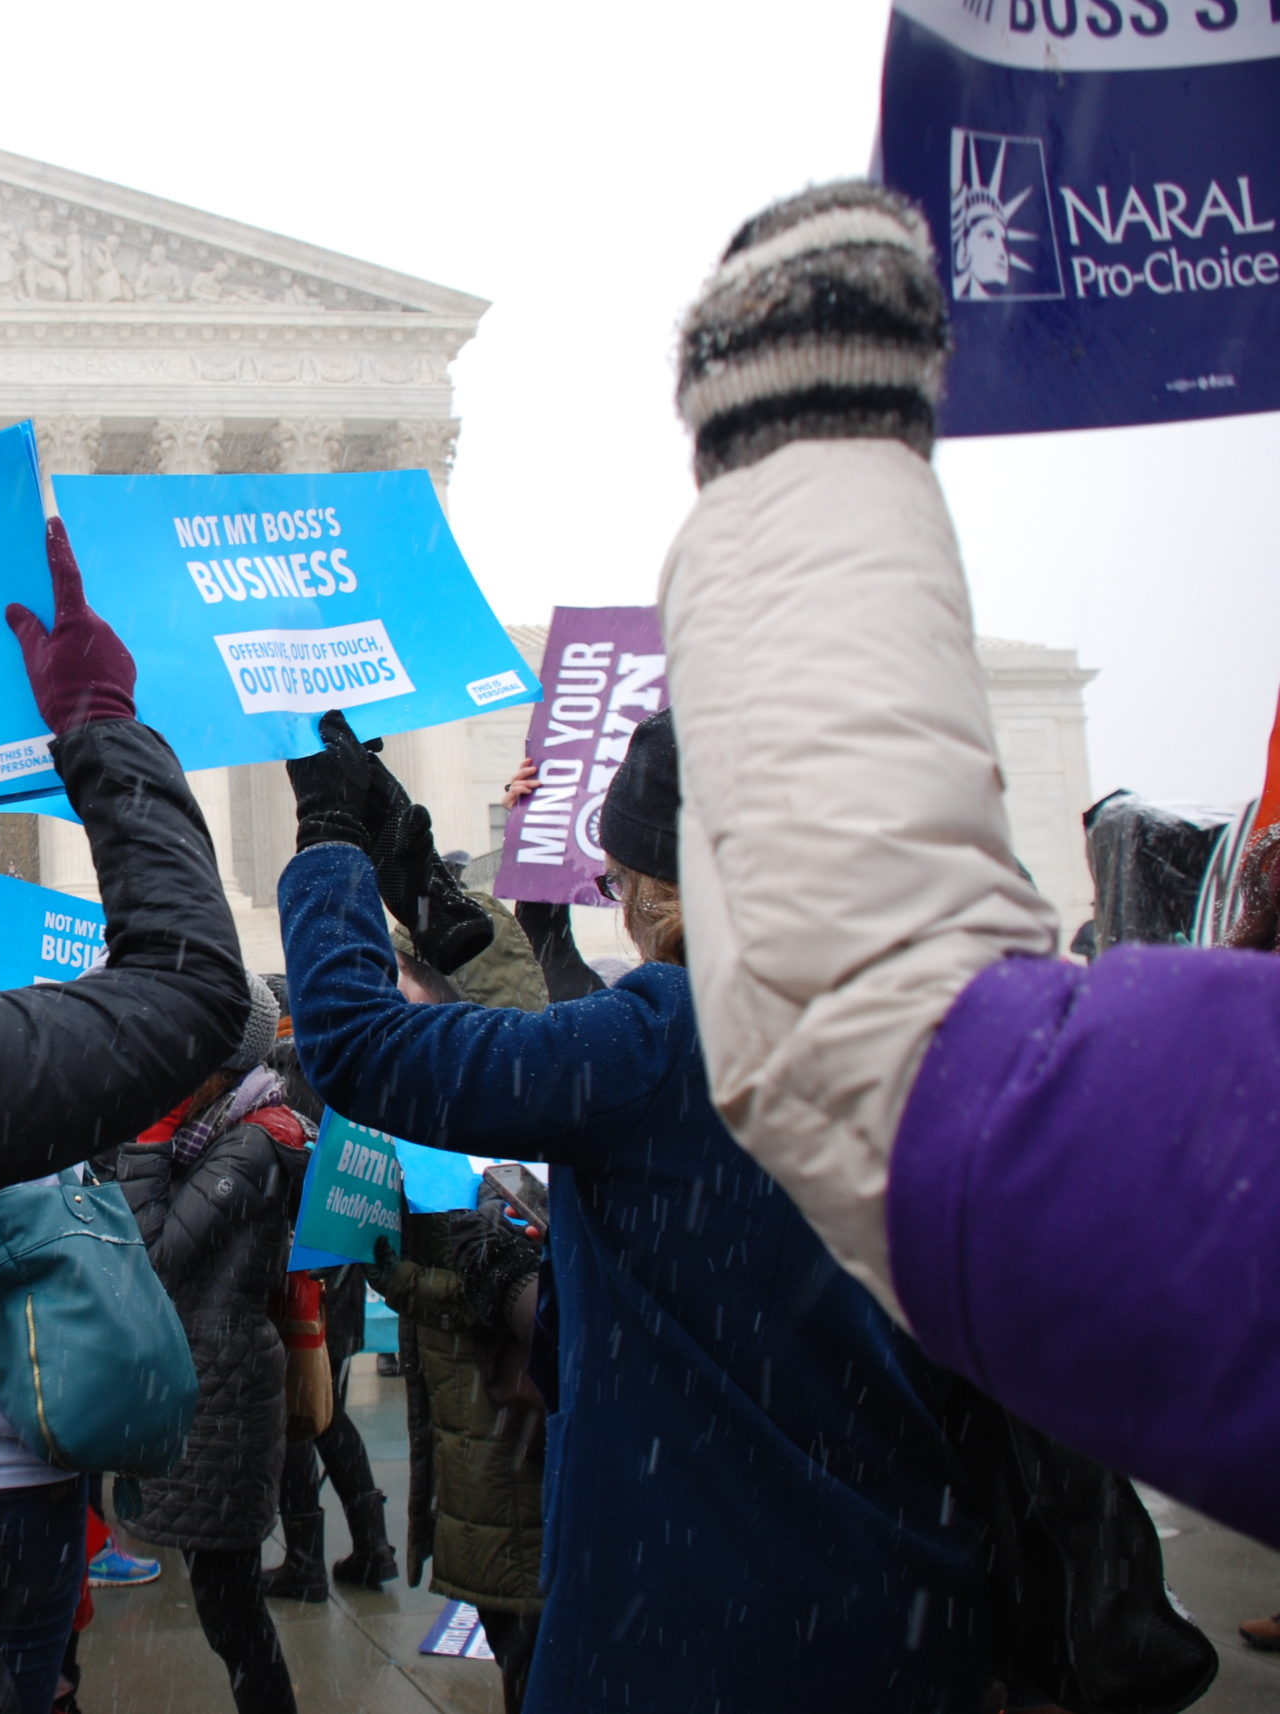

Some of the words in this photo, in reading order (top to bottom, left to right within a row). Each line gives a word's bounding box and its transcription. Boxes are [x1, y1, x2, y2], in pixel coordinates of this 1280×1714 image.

[1058, 176, 1275, 246] NARAL
[1070, 246, 1280, 299] Pro-Choice
[173, 515, 221, 548] NOT
[222, 513, 257, 545] MY
[261, 507, 342, 543] BOSS'S
[186, 547, 358, 604] BUSINESS
[228, 641, 290, 662] OFFENSIVE,
[289, 642, 311, 660] OUT
[312, 642, 330, 660] OF
[329, 636, 384, 658] TOUCH,
[239, 665, 281, 695] OUT
[281, 666, 299, 695] OF
[301, 656, 396, 695] BOUNDS
[543, 641, 615, 748] YOUR
[23, 745, 34, 757] IS
[516, 758, 584, 866] MIND
[44, 910, 73, 933] NOT
[74, 918, 97, 939] MY
[336, 1139, 388, 1186] BIRTH
